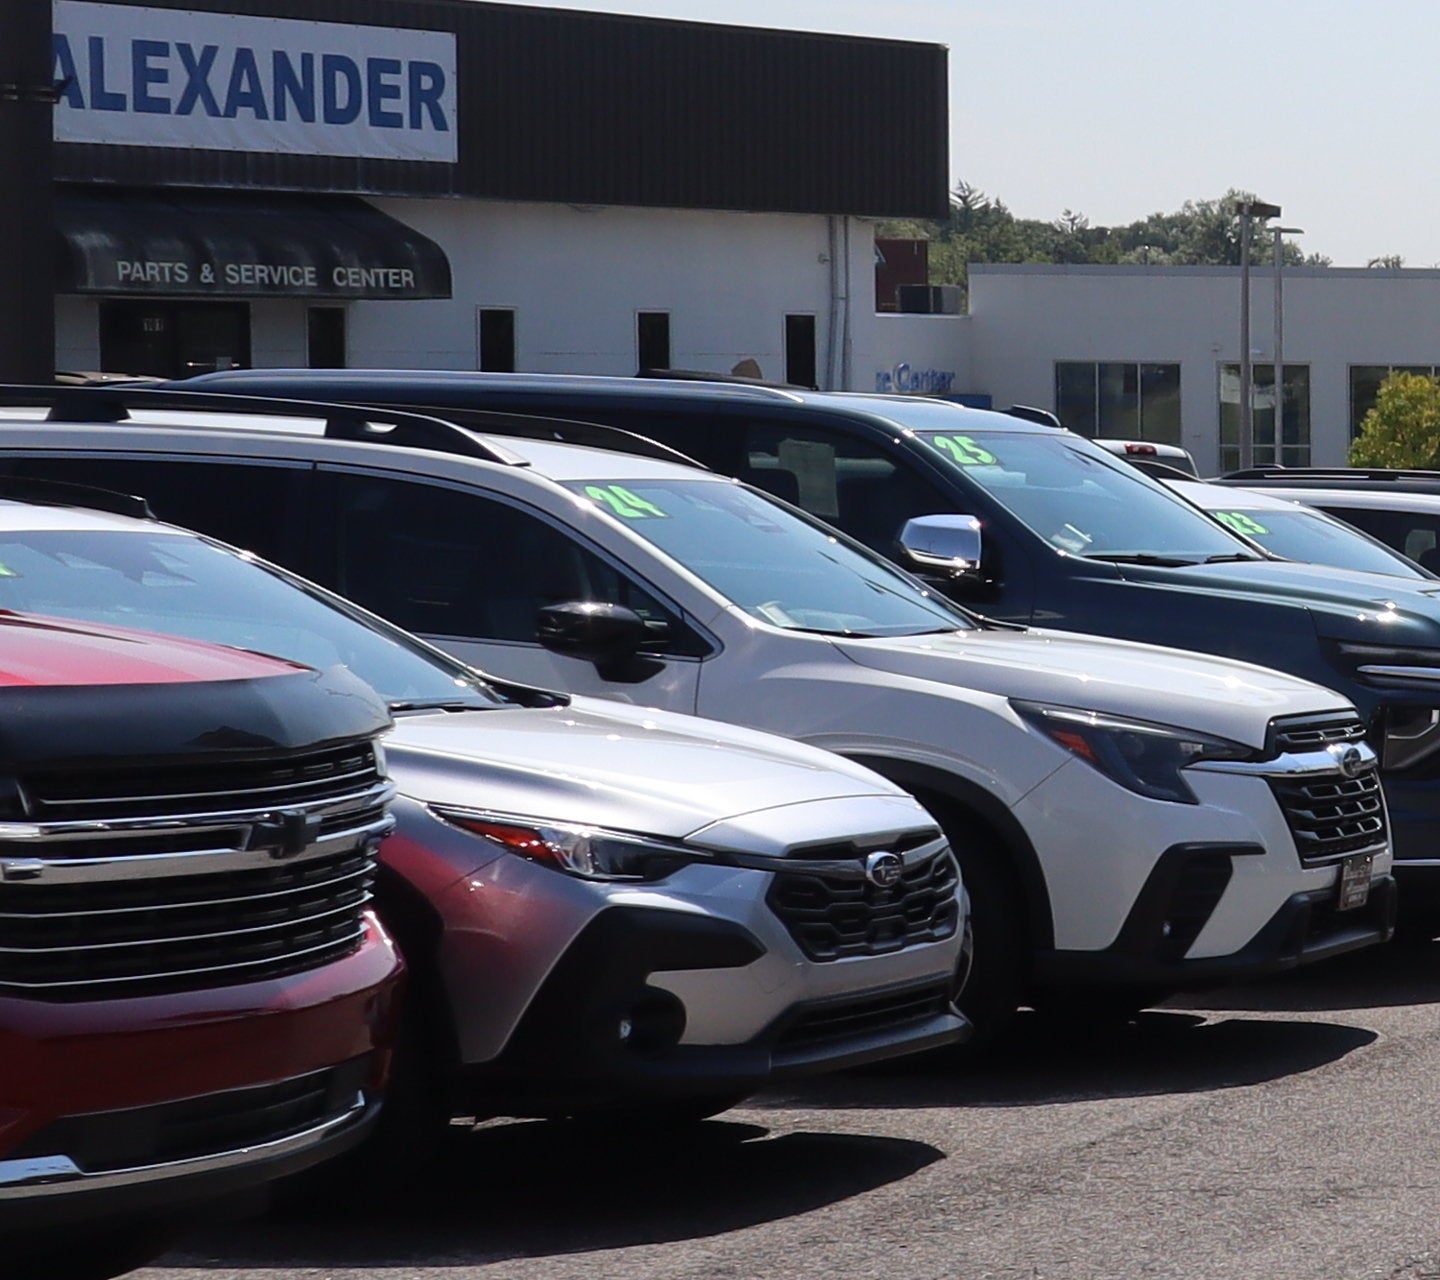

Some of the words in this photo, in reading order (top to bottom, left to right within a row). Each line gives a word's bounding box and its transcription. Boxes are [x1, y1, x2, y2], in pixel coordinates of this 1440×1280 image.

[52, 33, 449, 132] ALEXANDER
[116, 261, 188, 284] PARTS
[199, 263, 216, 284] &
[225, 263, 318, 287] SERVICE
[332, 268, 416, 289] CENTER
[933, 435, 996, 465] 25
[585, 485, 669, 518] 24
[1215, 511, 1270, 535] 23
